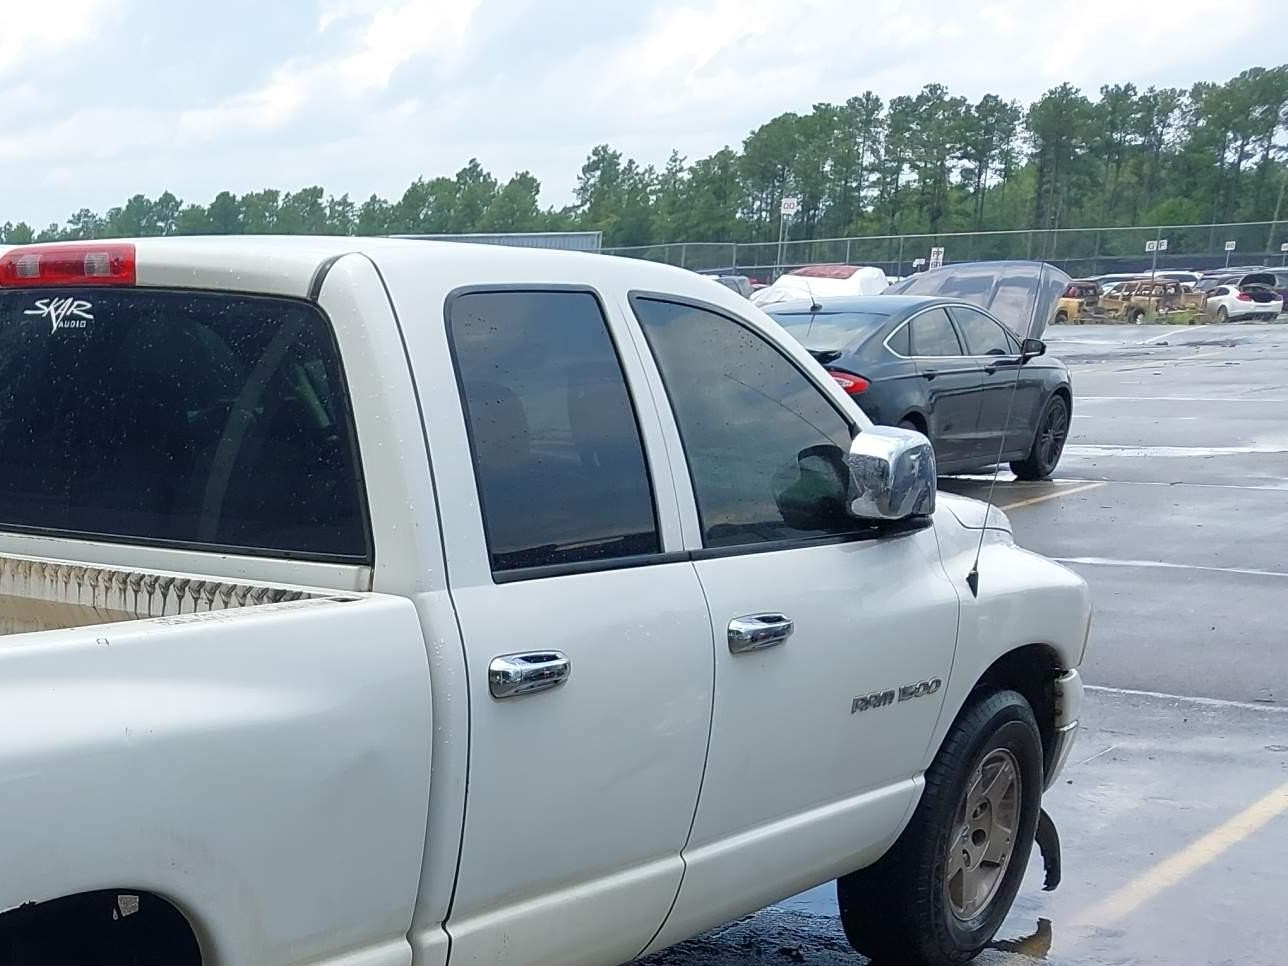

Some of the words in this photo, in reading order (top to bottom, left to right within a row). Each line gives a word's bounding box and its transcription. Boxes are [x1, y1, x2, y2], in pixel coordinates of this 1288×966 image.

[58, 320, 87, 328] AUDIO
[850, 689, 896, 714] RAM
[897, 677, 942, 702] 1500
